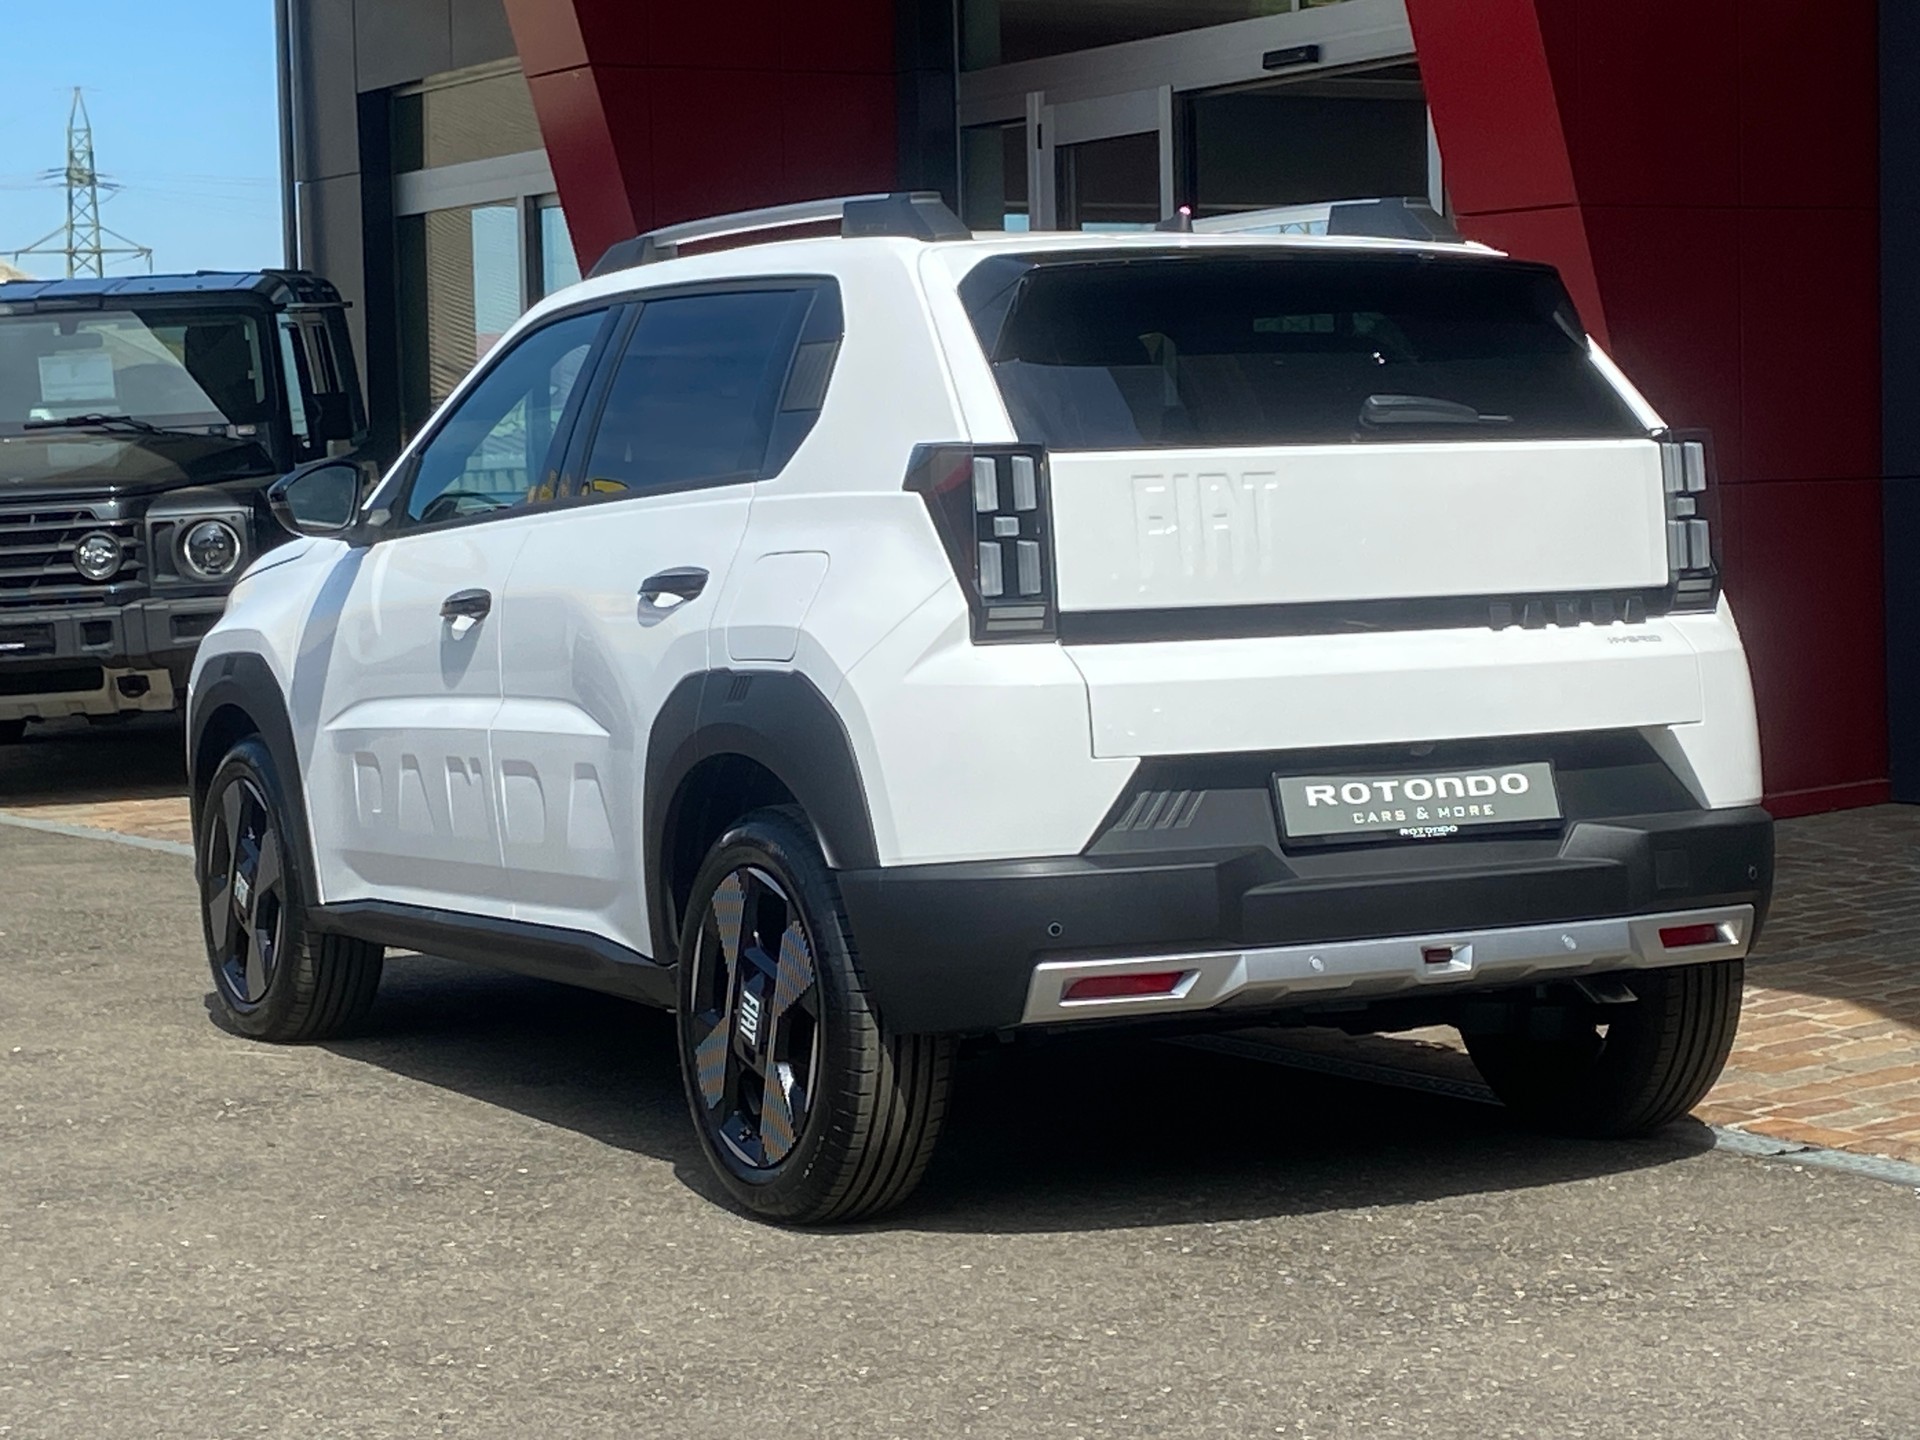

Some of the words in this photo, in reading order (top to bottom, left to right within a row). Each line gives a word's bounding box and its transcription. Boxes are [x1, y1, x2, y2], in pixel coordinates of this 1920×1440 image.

[1130, 471, 1278, 577] FIAT
[353, 751, 616, 851] PANDA
[1305, 773, 1529, 807] ROTONDO
[1353, 809, 1406, 824] CARS
[1416, 807, 1429, 820] &
[1438, 804, 1495, 818] MORE
[740, 990, 760, 1046] FIAT
